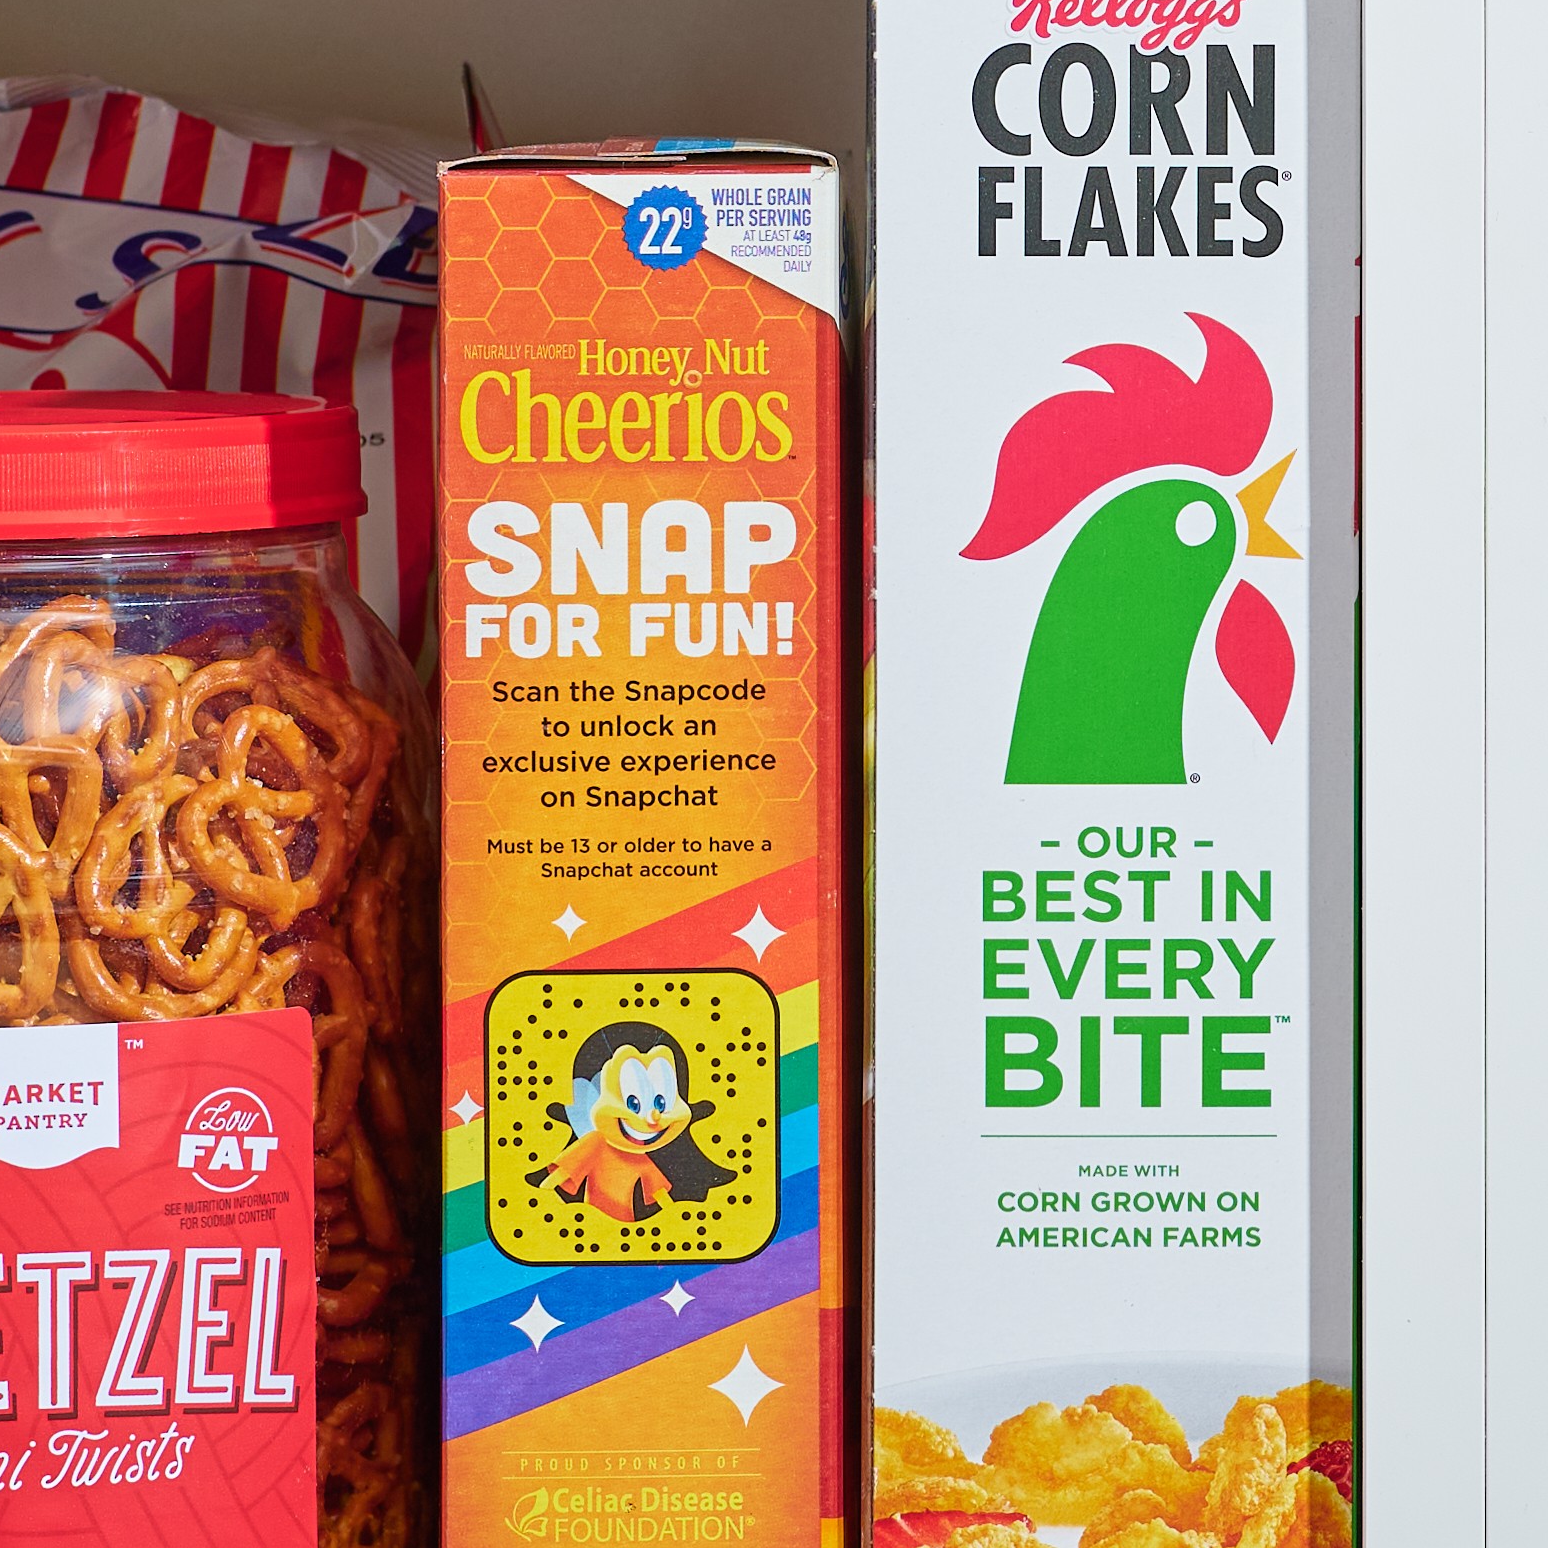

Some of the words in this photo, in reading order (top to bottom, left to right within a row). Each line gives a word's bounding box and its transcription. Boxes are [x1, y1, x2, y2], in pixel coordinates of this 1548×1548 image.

[972, 43, 1275, 157] CORN
[712, 188, 762, 206] WHOLE
[767, 188, 811, 206] GRAIN
[978, 165, 1283, 258] FLAKES
[578, 339, 692, 384] Honey
[704, 338, 769, 376] Nut
[460, 369, 793, 463] Cheerios
[465, 500, 797, 597] SNAP
[540, 787, 575, 807] on
[586, 785, 718, 810] Snapchat
[985, 1016, 1271, 1108] BITE
[177, 1134, 277, 1172] FAT
[996, 1227, 1152, 1248] AMERICAN
[1163, 1227, 1261, 1247] FARMS
[41, 1422, 194, 1493] Twists
